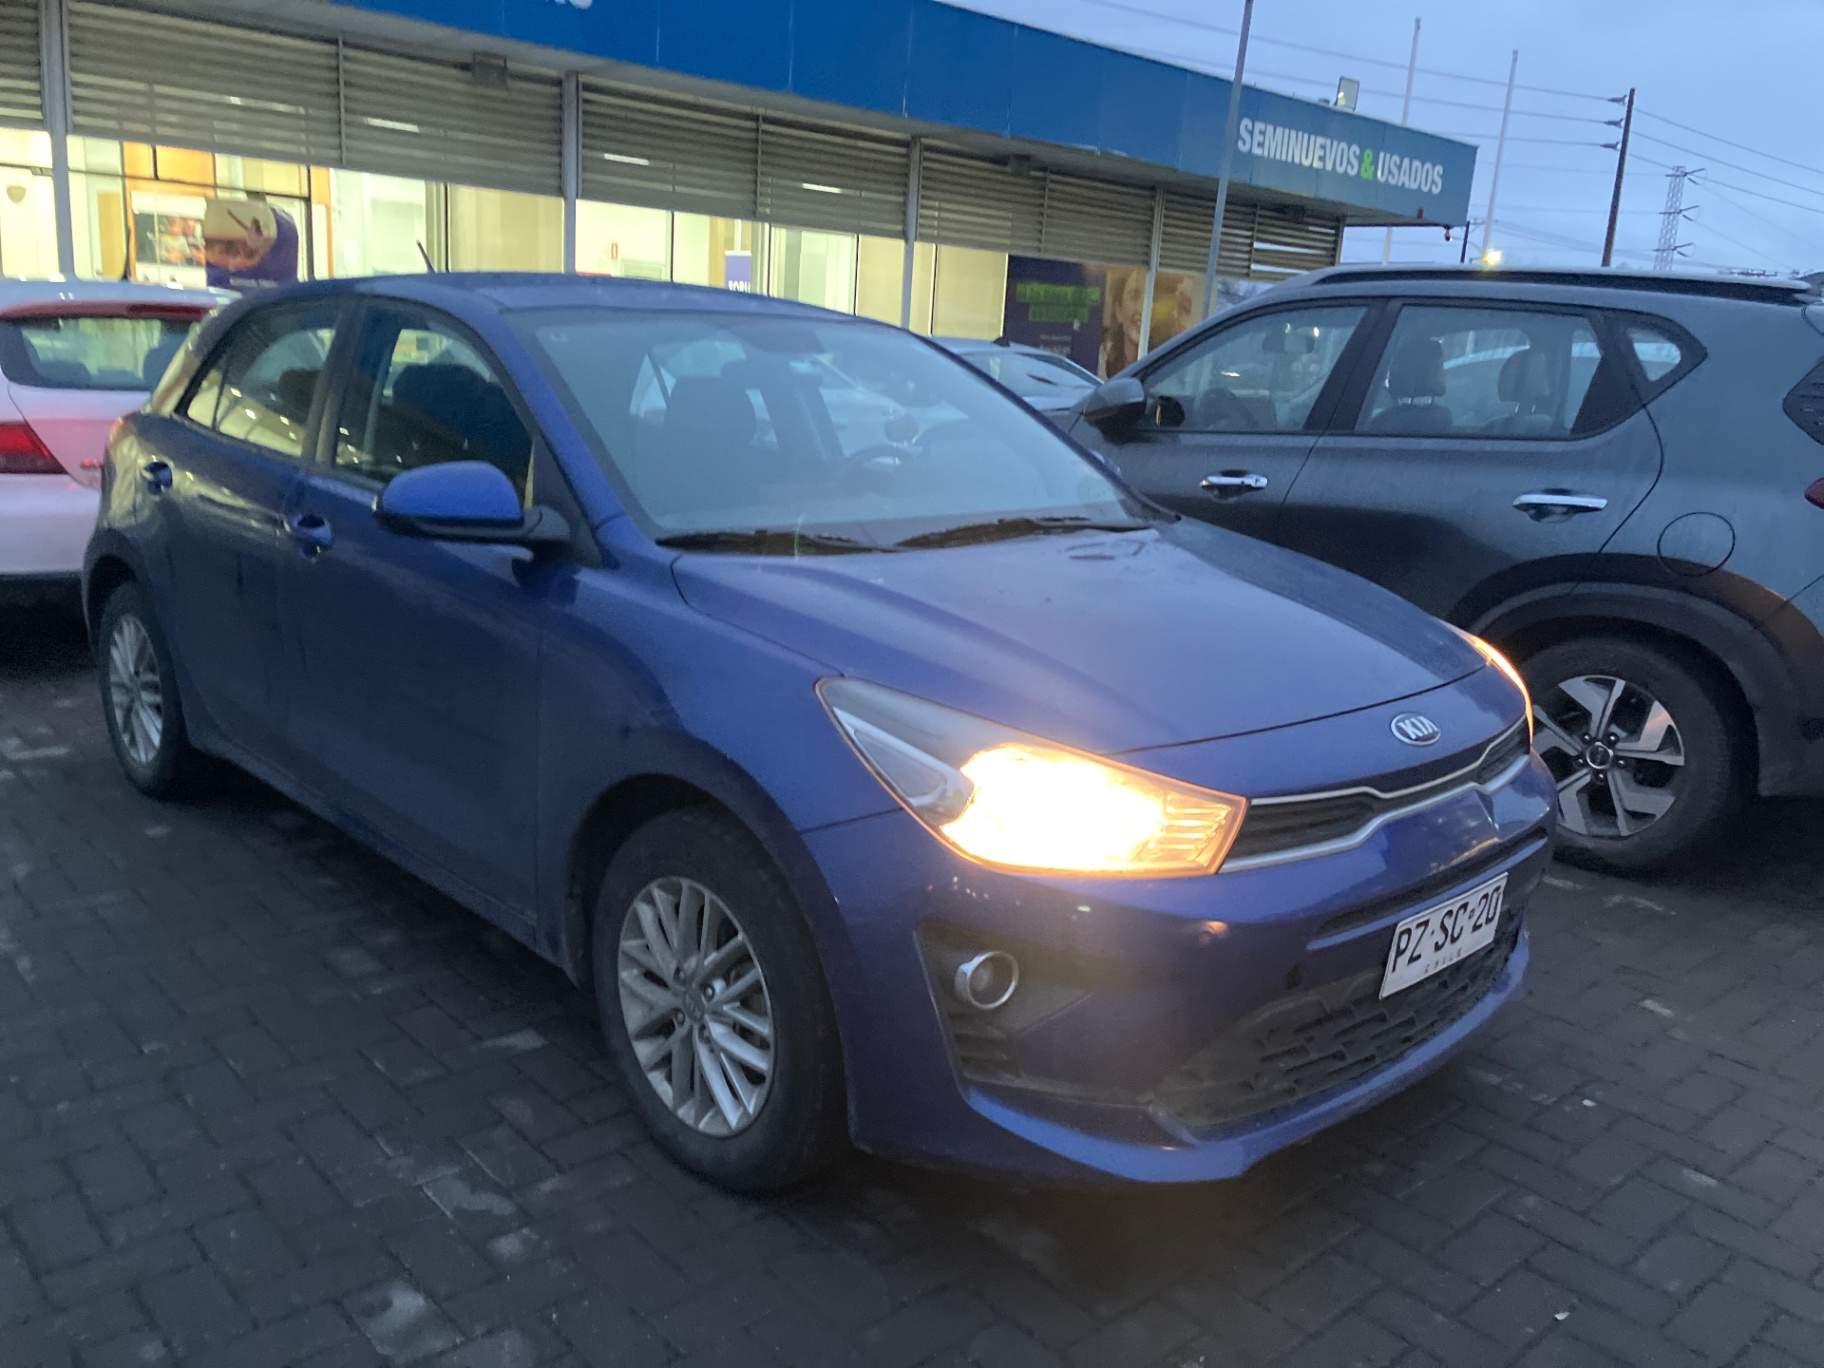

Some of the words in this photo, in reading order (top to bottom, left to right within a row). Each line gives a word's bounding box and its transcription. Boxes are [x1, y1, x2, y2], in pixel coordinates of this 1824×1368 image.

[1238, 117, 1360, 177] SEMINUEVOS
[1377, 151, 1443, 195] USADOS
[1397, 715, 1438, 740] KIA
